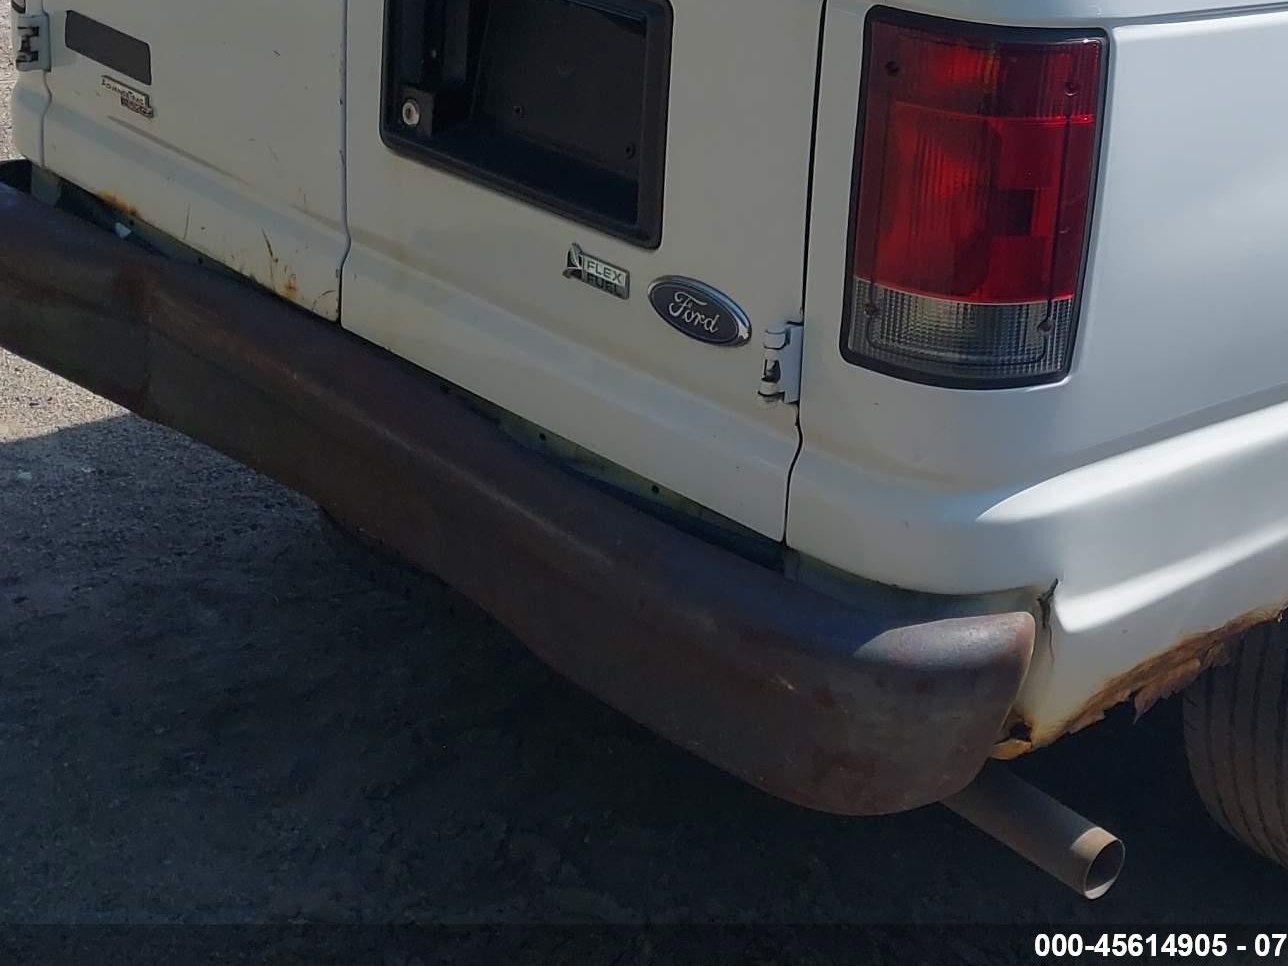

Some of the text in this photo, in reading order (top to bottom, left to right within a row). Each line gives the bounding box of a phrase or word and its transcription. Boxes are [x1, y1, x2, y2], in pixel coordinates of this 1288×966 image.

[587, 260, 623, 284] FLEX
[587, 272, 623, 298] FUEL
[668, 290, 720, 334] Ford
